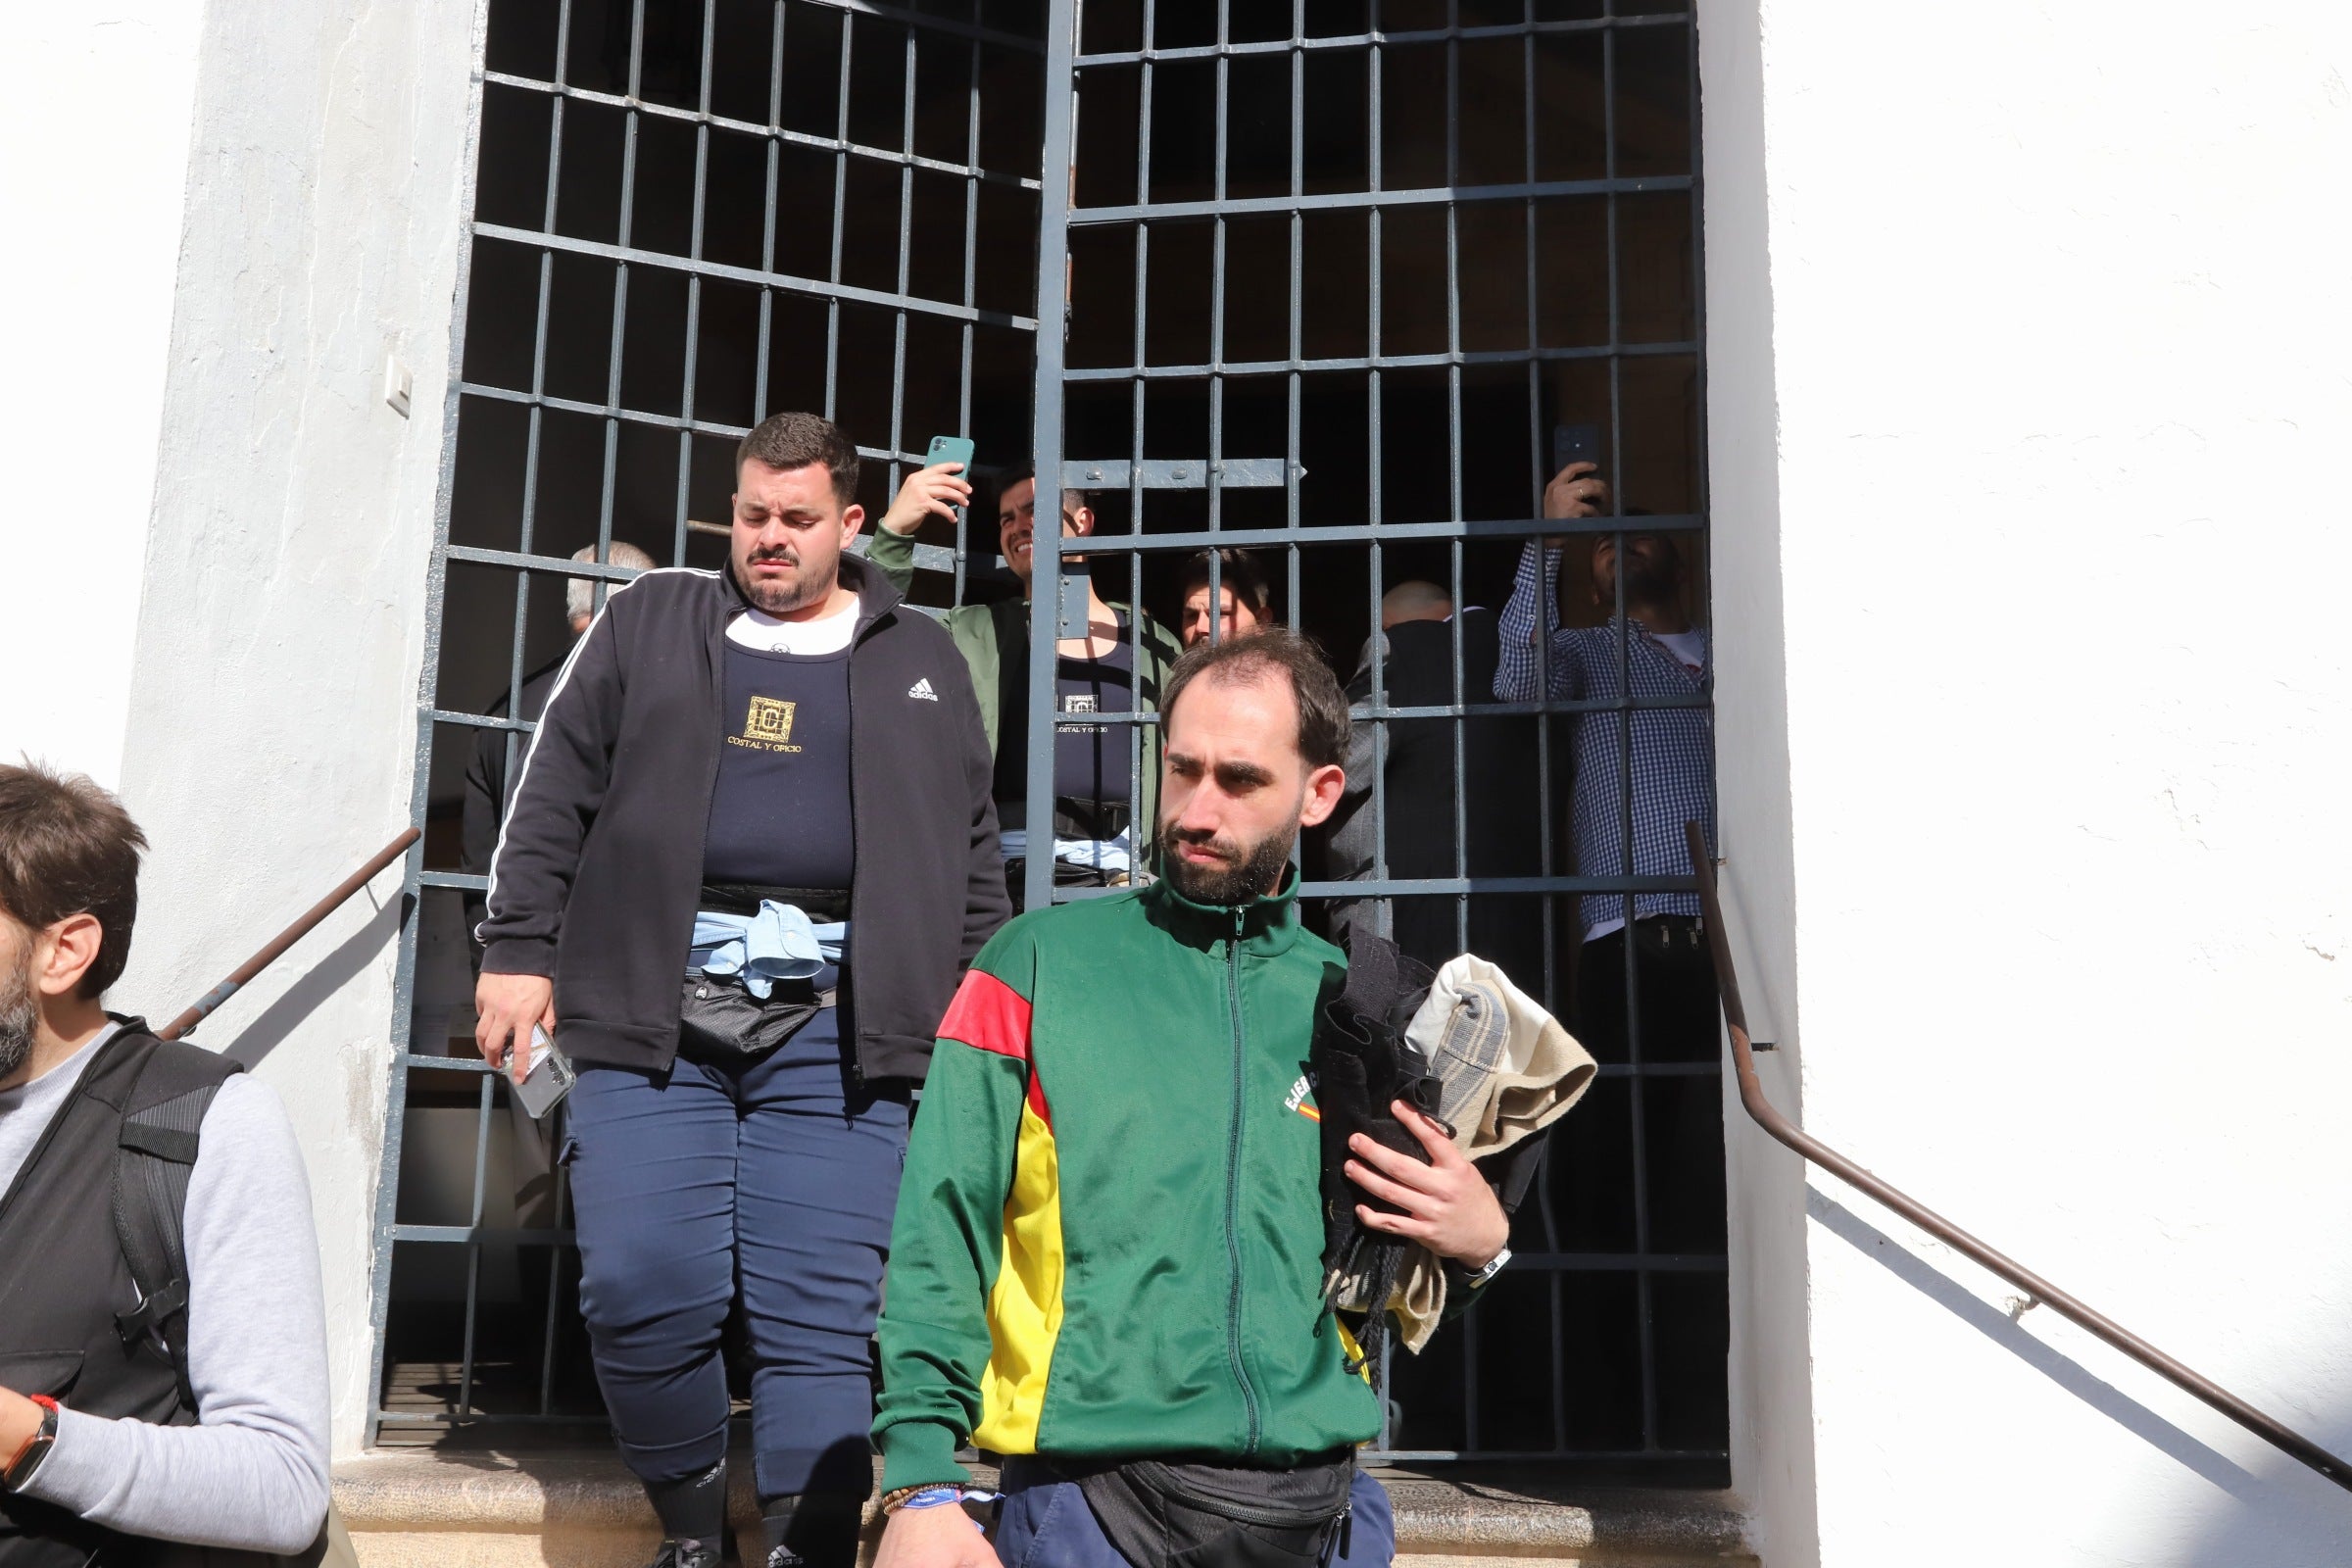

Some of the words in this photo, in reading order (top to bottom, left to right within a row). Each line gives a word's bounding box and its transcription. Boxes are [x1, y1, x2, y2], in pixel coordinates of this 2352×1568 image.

[908, 690, 938, 702] adidas
[727, 735, 762, 750] COSTAL
[773, 744, 802, 754] OFICIO
